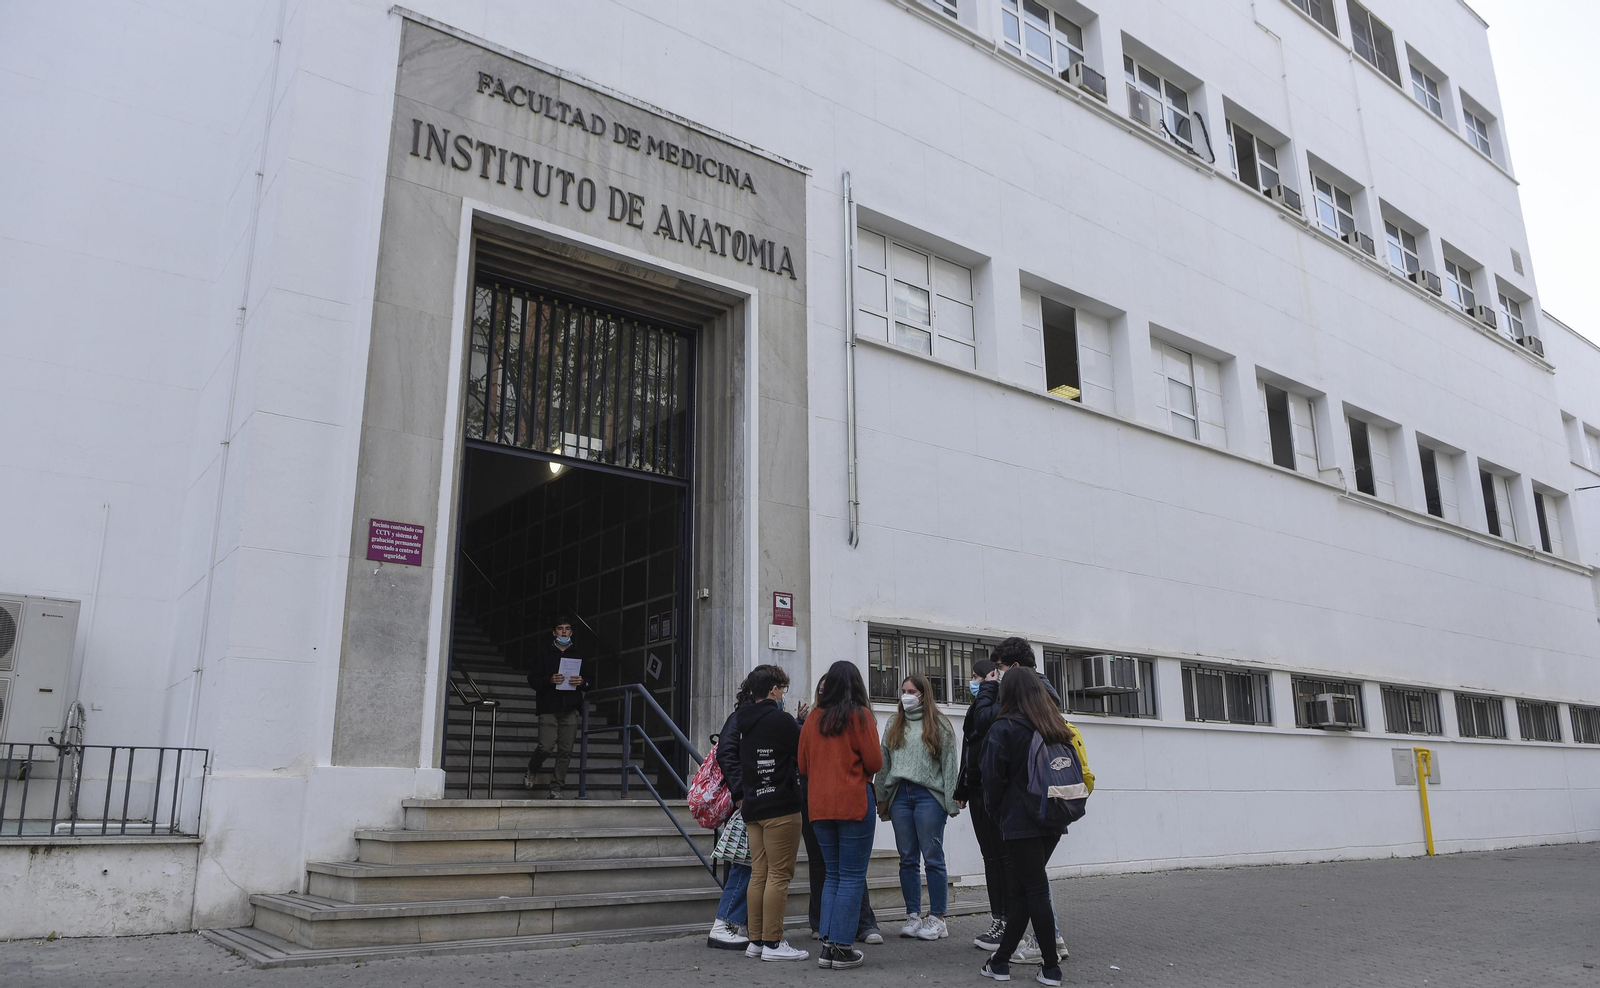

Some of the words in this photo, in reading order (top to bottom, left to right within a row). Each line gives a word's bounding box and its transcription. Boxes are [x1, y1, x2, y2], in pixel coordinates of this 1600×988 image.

[477, 71, 606, 135] FACULTAD
[613, 122, 641, 151] DE
[646, 135, 757, 194] MEDICINA
[410, 119, 596, 212] INSTITUTO
[608, 186, 645, 230] DE
[653, 204, 797, 280] ANATOMIA
[372, 521, 389, 529] Recinto
[390, 525, 414, 533] controlado
[395, 532, 412, 540] sistema
[371, 544, 394, 552] conectado
[395, 540, 421, 548] permanente
